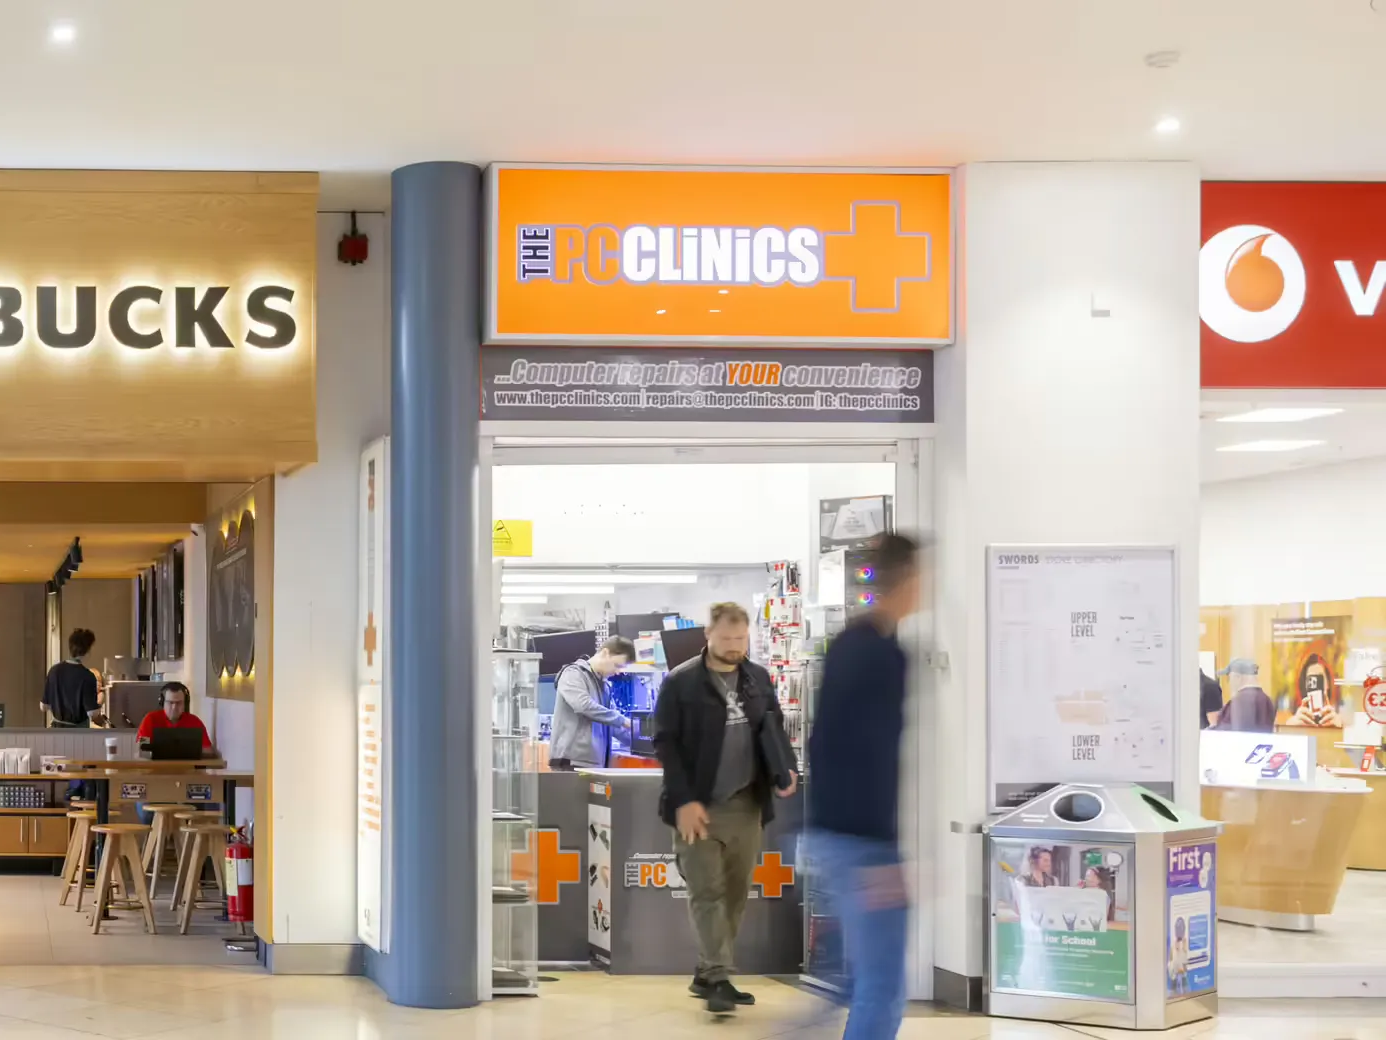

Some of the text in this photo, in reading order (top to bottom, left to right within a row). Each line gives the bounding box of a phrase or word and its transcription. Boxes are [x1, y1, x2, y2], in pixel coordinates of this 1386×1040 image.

[520, 227, 551, 280] THE
[617, 361, 698, 388] repairs
[699, 362, 724, 385] at
[726, 361, 781, 386] YOUR
[782, 363, 922, 389] convenience
[998, 555, 1039, 565] SWORDS
[1071, 611, 1097, 623] UPPER
[1071, 625, 1095, 637] LEVEL
[1072, 735, 1100, 747] LOWER
[1072, 748, 1096, 760] LEVEL
[1169, 846, 1201, 872] First
[626, 863, 638, 886] THE
[640, 863, 667, 886] PC
[1062, 935, 1096, 946] School
